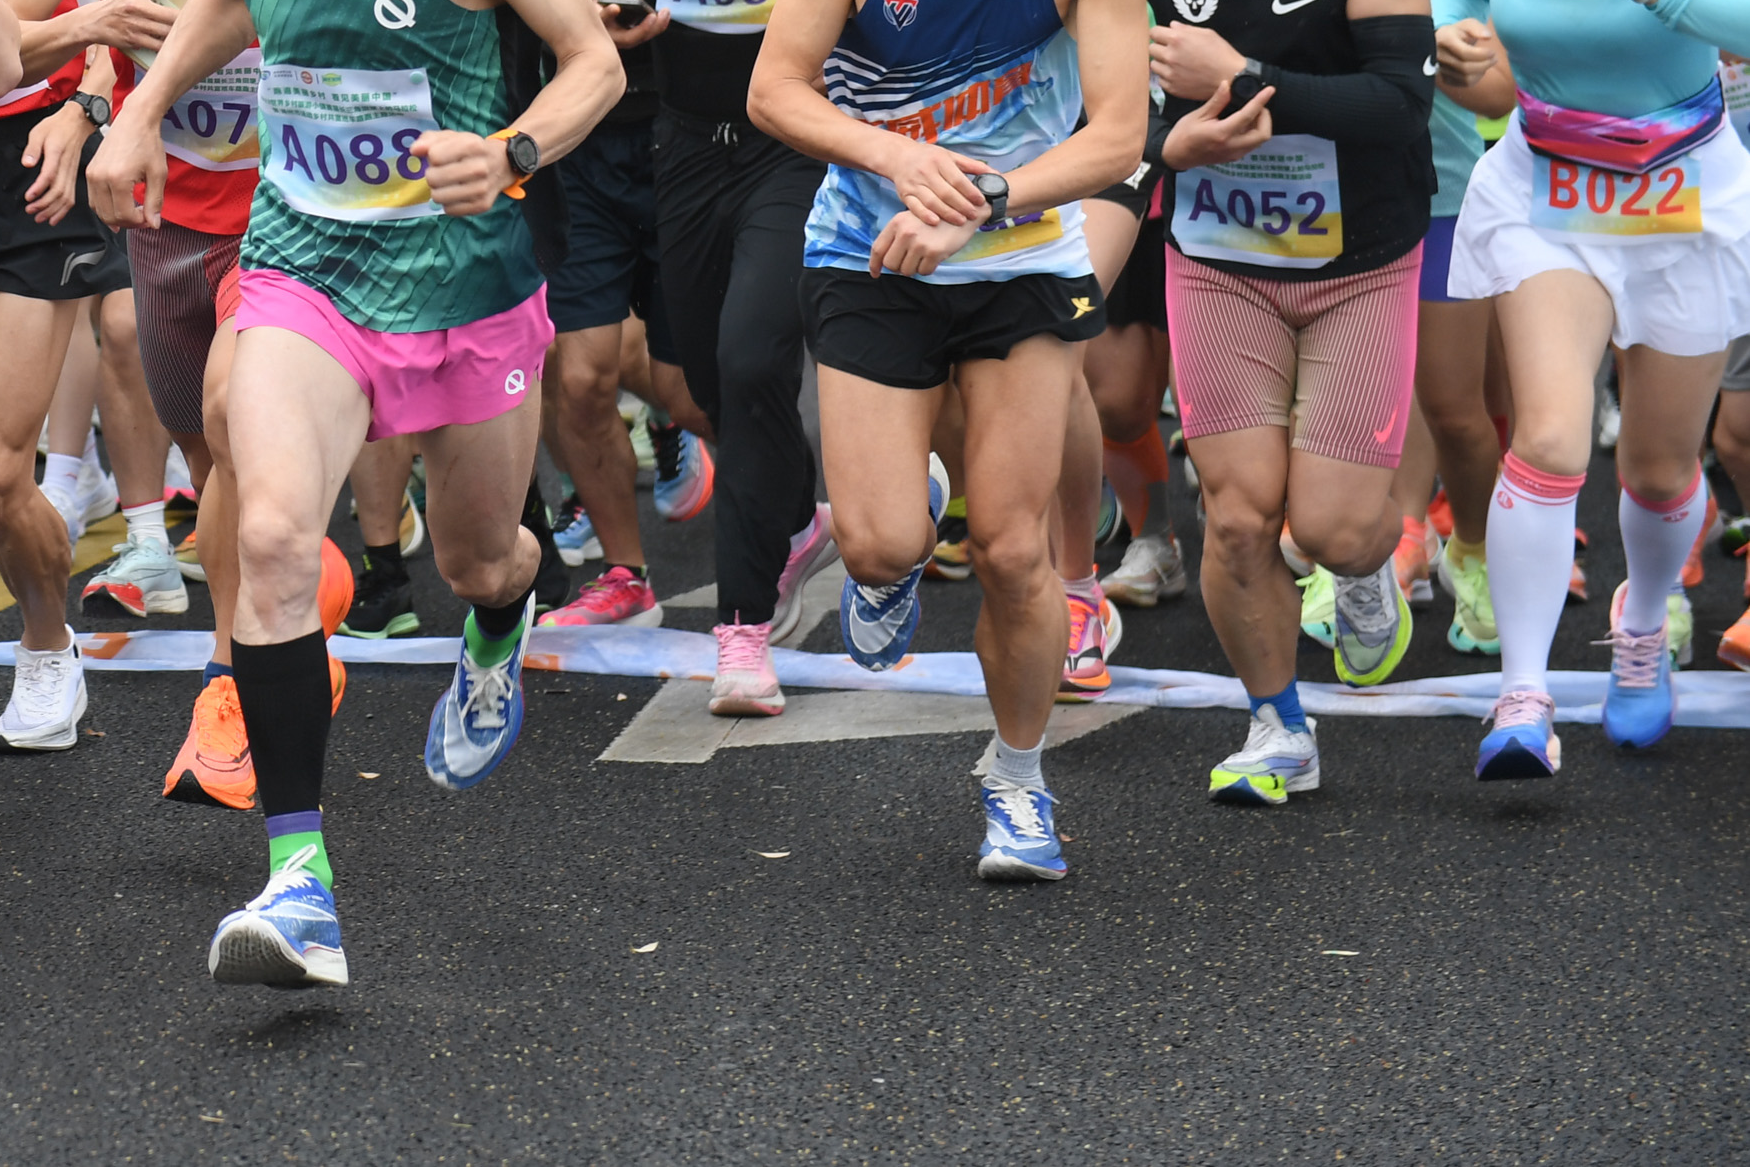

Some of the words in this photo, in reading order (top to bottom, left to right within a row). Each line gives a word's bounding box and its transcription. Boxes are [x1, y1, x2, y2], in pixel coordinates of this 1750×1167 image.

[282, 124, 429, 185] A088
[1188, 178, 1329, 235] A052
[1548, 159, 1685, 216] B022
